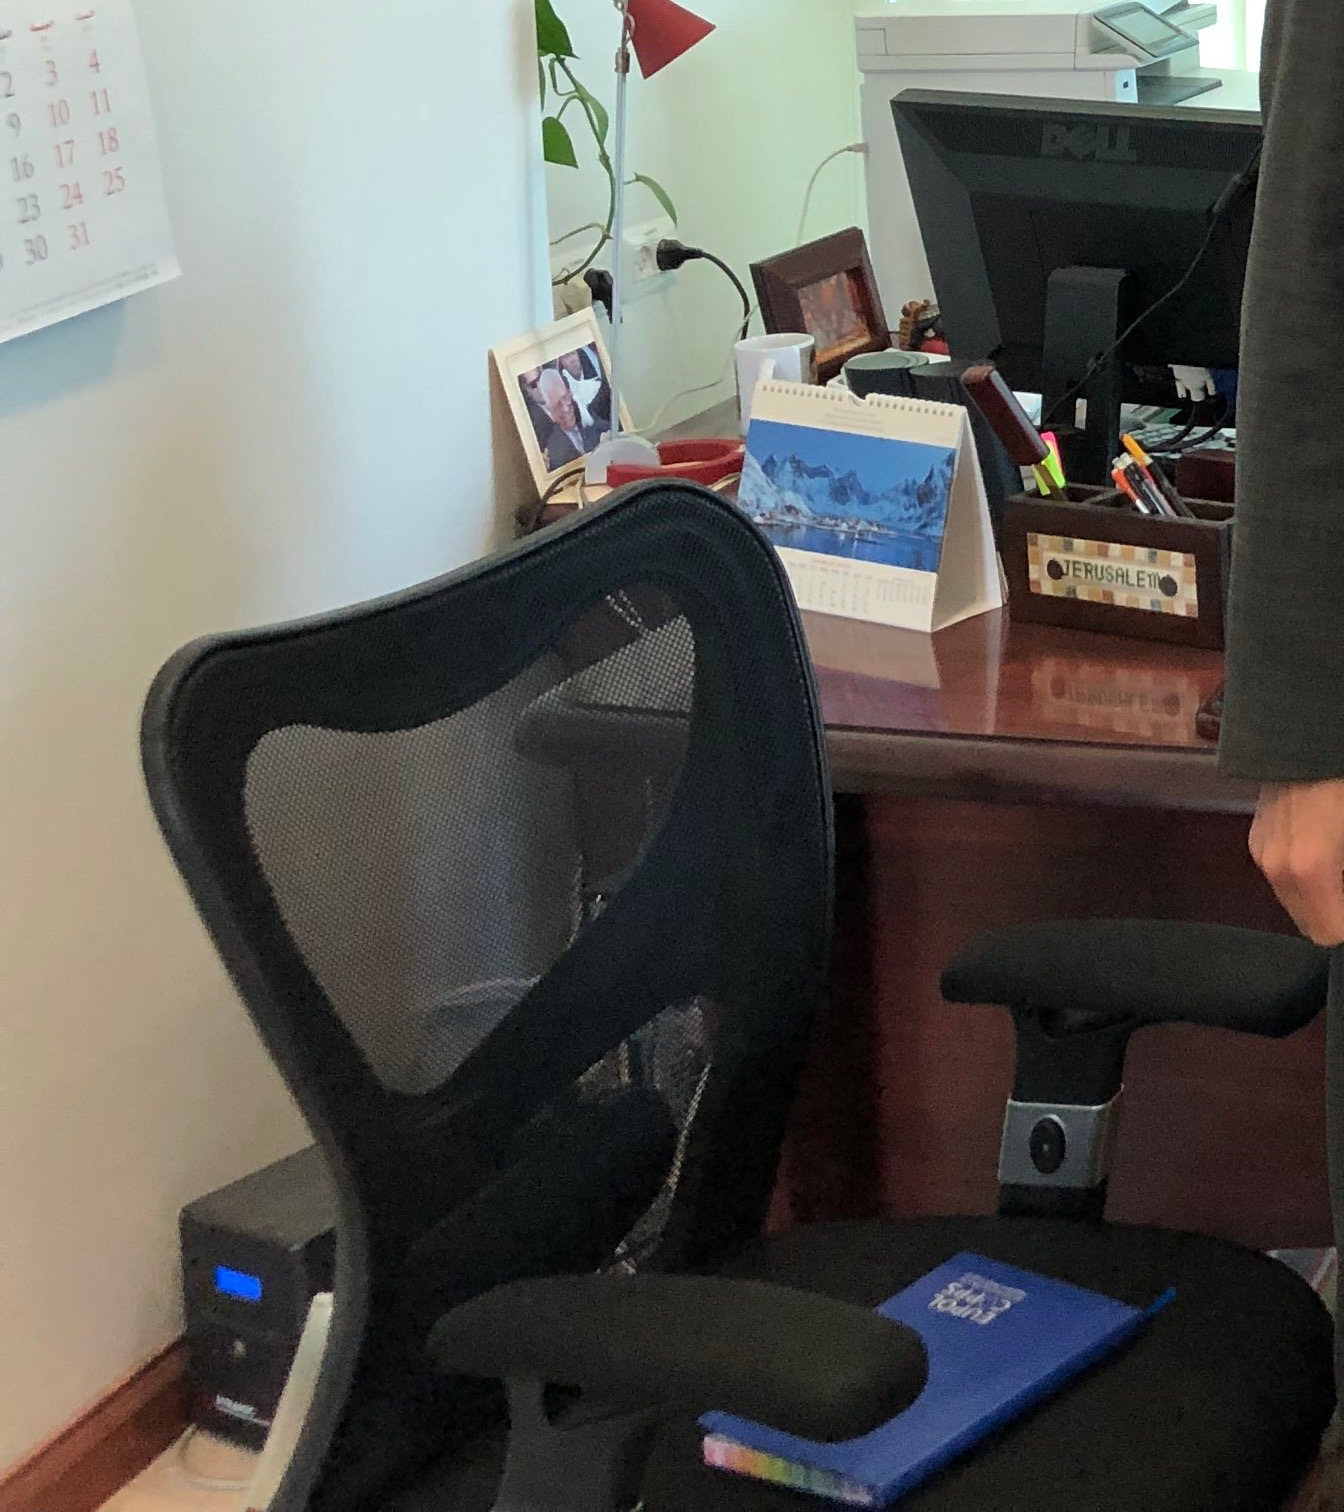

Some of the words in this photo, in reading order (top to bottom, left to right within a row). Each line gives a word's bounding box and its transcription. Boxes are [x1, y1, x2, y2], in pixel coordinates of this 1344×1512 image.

[45, 59, 59, 86] 3
[88, 48, 101, 74] 4
[49, 98, 70, 128] 10
[91, 88, 111, 116] 11
[10, 152, 35, 182] 16
[54, 139, 75, 169] 17
[97, 127, 119, 155] 18
[1041, 121, 1137, 160] DELL
[17, 193, 41, 224] 23
[59, 180, 83, 210] 24
[102, 167, 125, 196] 25
[24, 235, 48, 265] 30
[68, 221, 90, 251] 31
[1061, 559, 1160, 589] JERUSALEM
